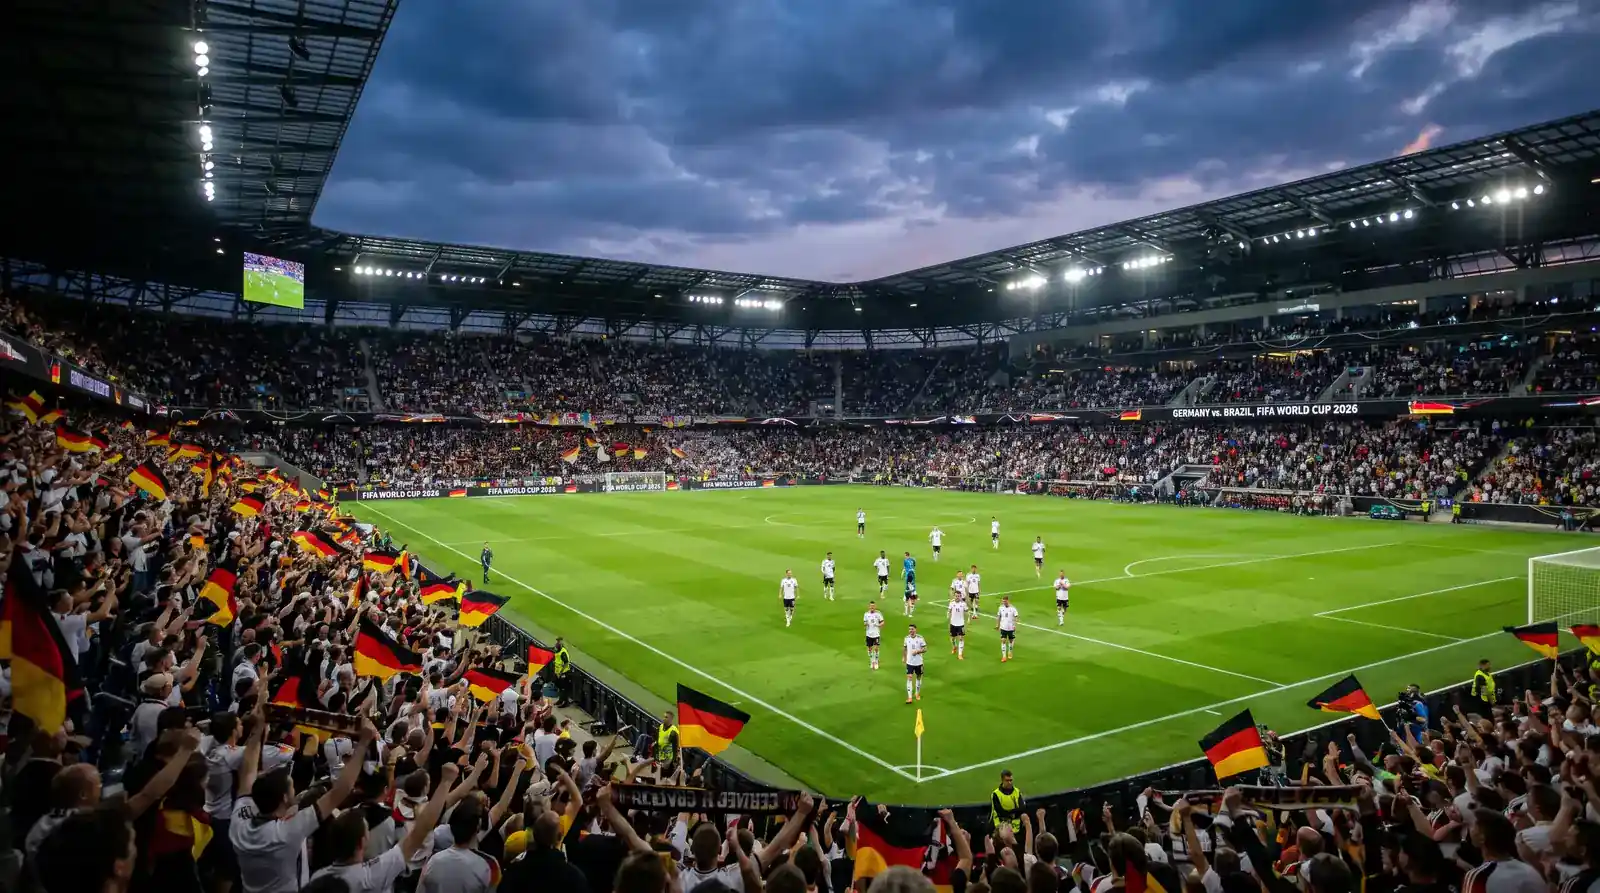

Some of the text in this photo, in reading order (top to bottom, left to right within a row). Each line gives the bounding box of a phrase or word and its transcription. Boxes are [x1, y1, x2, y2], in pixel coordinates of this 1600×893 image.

[1173, 408, 1210, 418] GERMANY
[1224, 408, 1255, 418] BRAZIL,
[1257, 407, 1275, 416] FIFA
[1277, 405, 1309, 415] WORLD
[1312, 405, 1331, 415] CUP
[1333, 404, 1358, 414] 2026
[362, 491, 379, 499] FIFA
